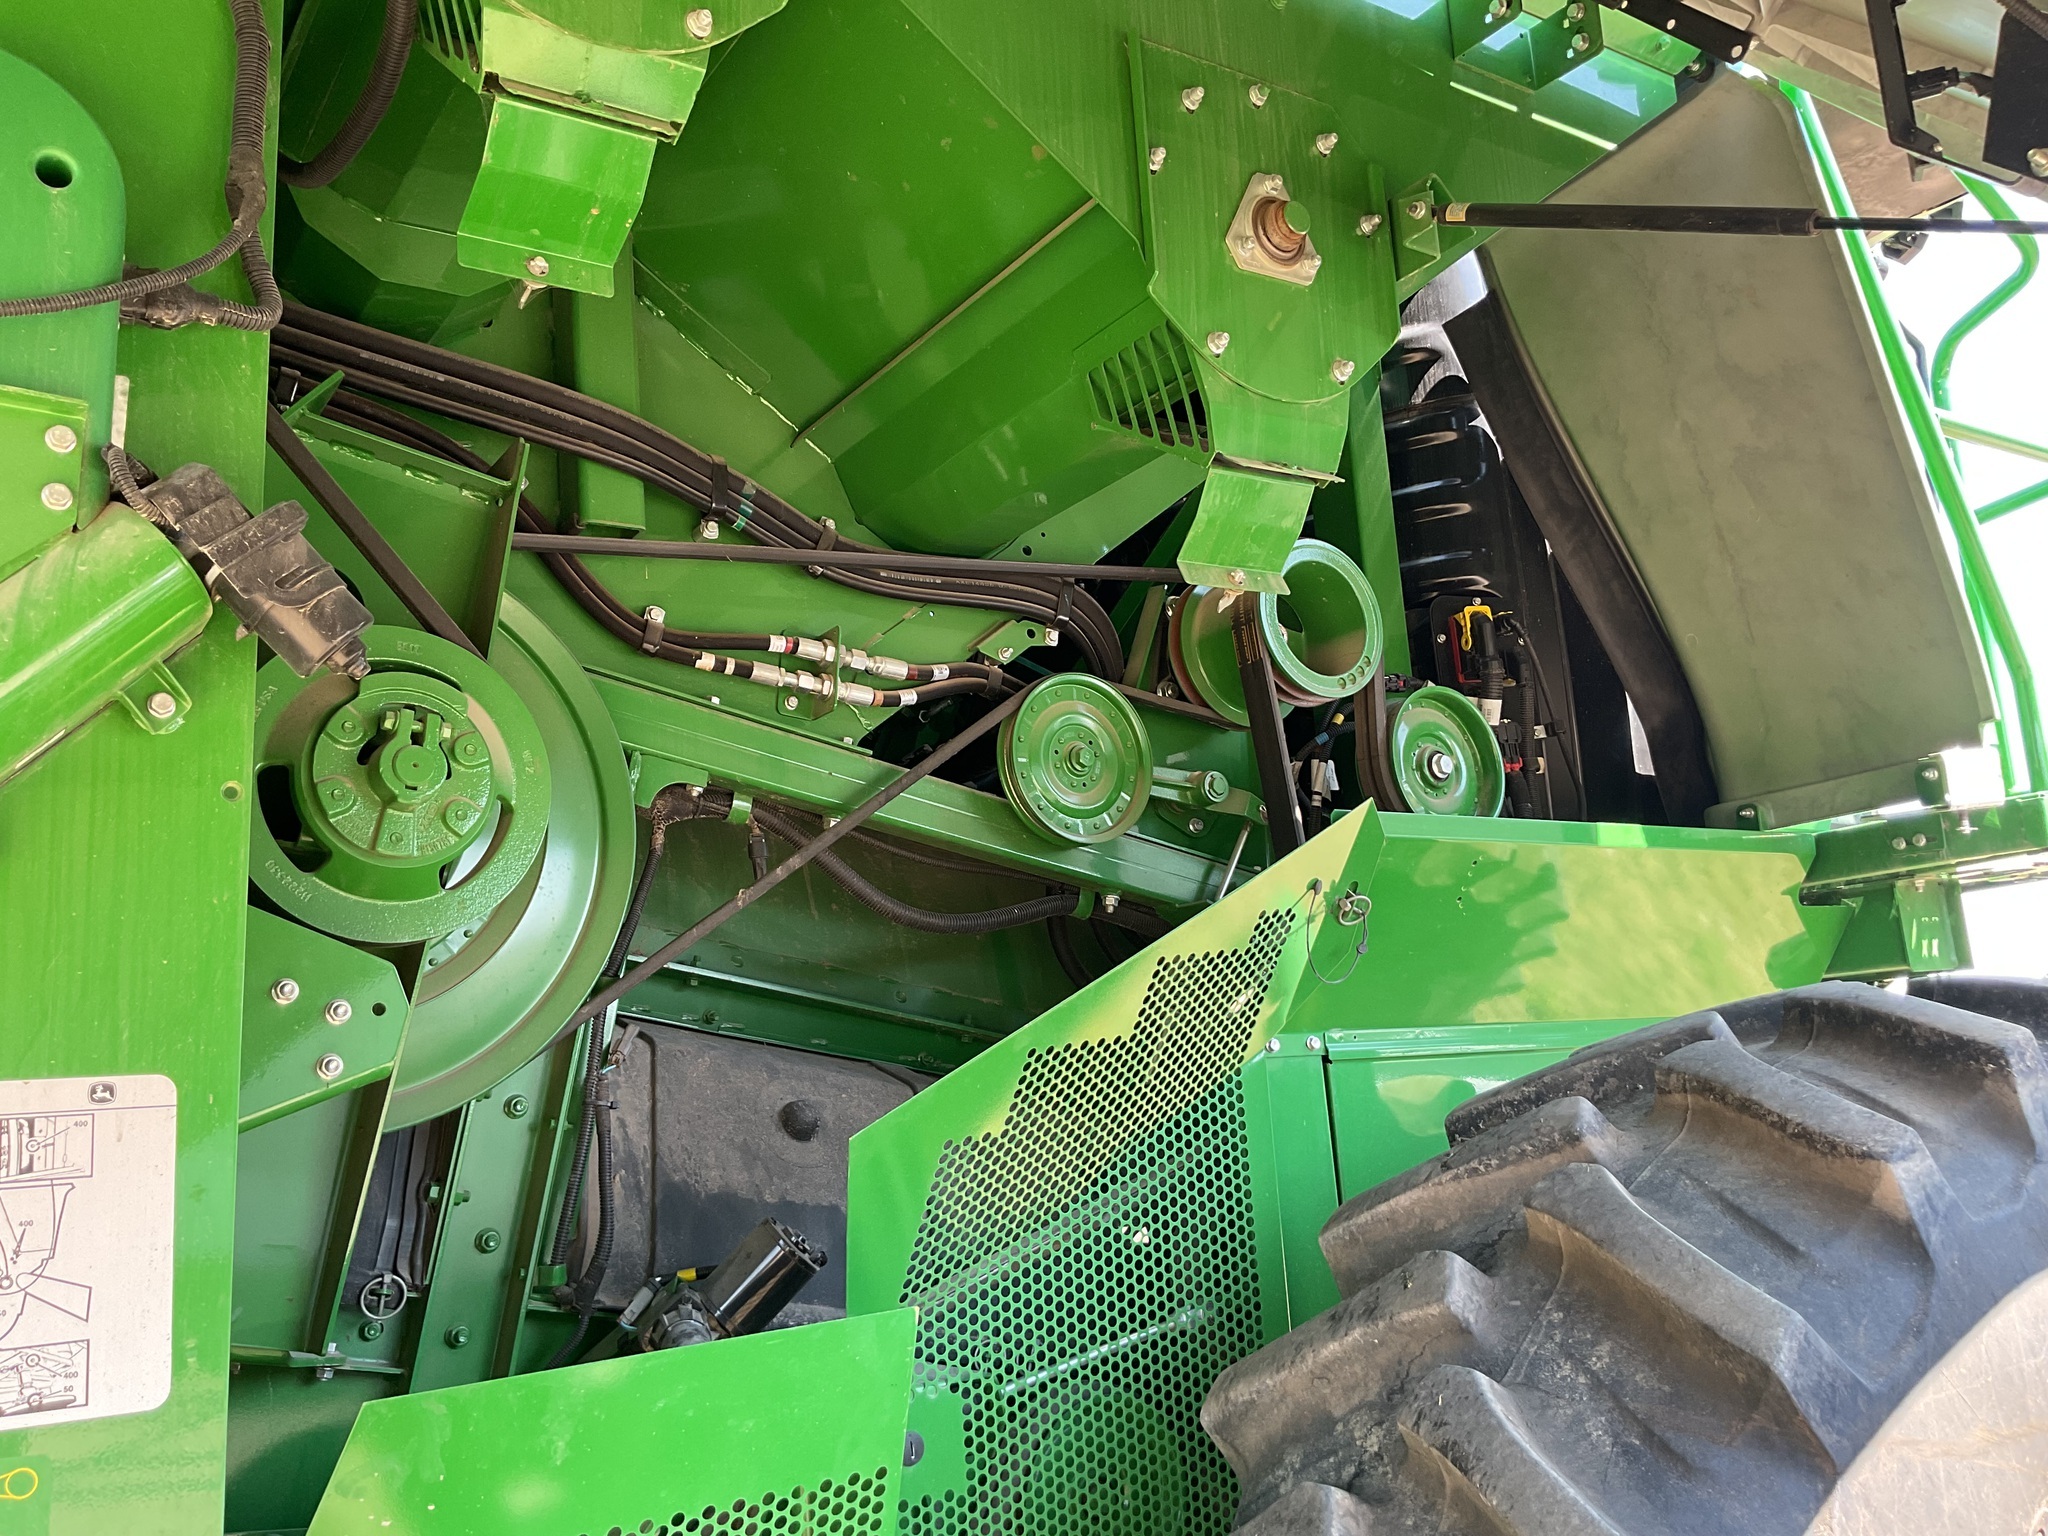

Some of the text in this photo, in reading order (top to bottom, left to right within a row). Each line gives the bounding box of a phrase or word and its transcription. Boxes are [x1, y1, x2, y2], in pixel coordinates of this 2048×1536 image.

[73, 1120, 89, 1128] 400
[18, 1219, 34, 1227] 400
[63, 1370, 79, 1379] 400
[63, 1385, 74, 1393] 50
